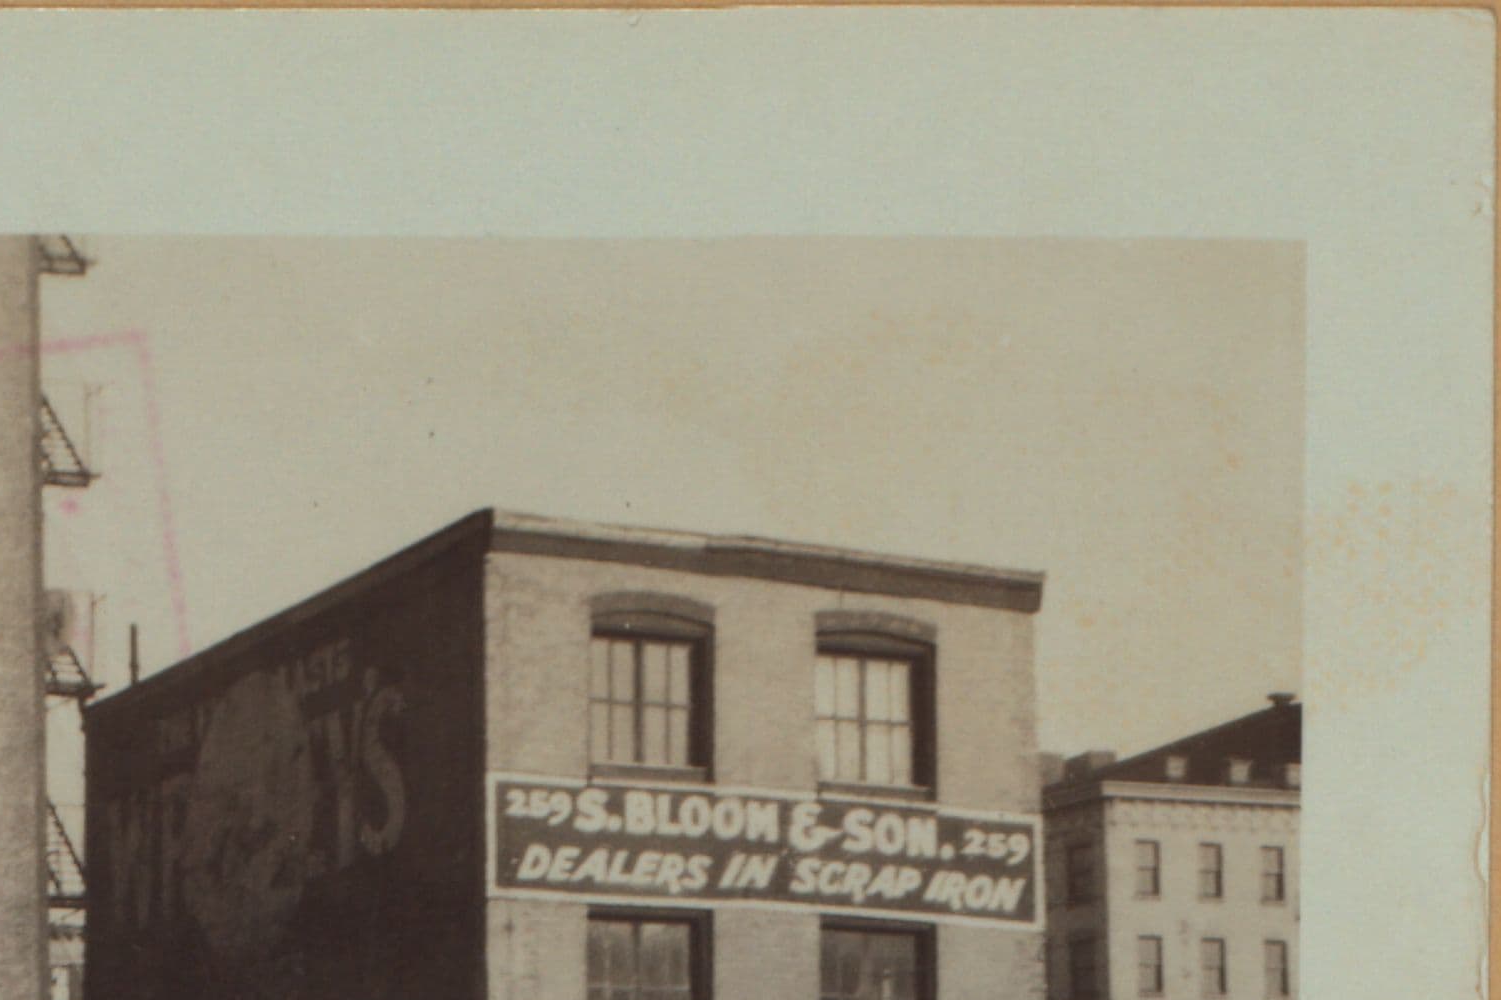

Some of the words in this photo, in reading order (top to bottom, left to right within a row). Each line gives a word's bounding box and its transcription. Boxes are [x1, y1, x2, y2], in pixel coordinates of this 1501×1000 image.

[505, 788, 572, 826] 259
[624, 790, 779, 843] BLOOM
[789, 802, 842, 852] &
[961, 828, 1031, 866] 259
[516, 842, 713, 895] DEALERS
[718, 851, 779, 890] IN
[789, 857, 922, 904] SCRAP
[923, 870, 1026, 915] IRON
